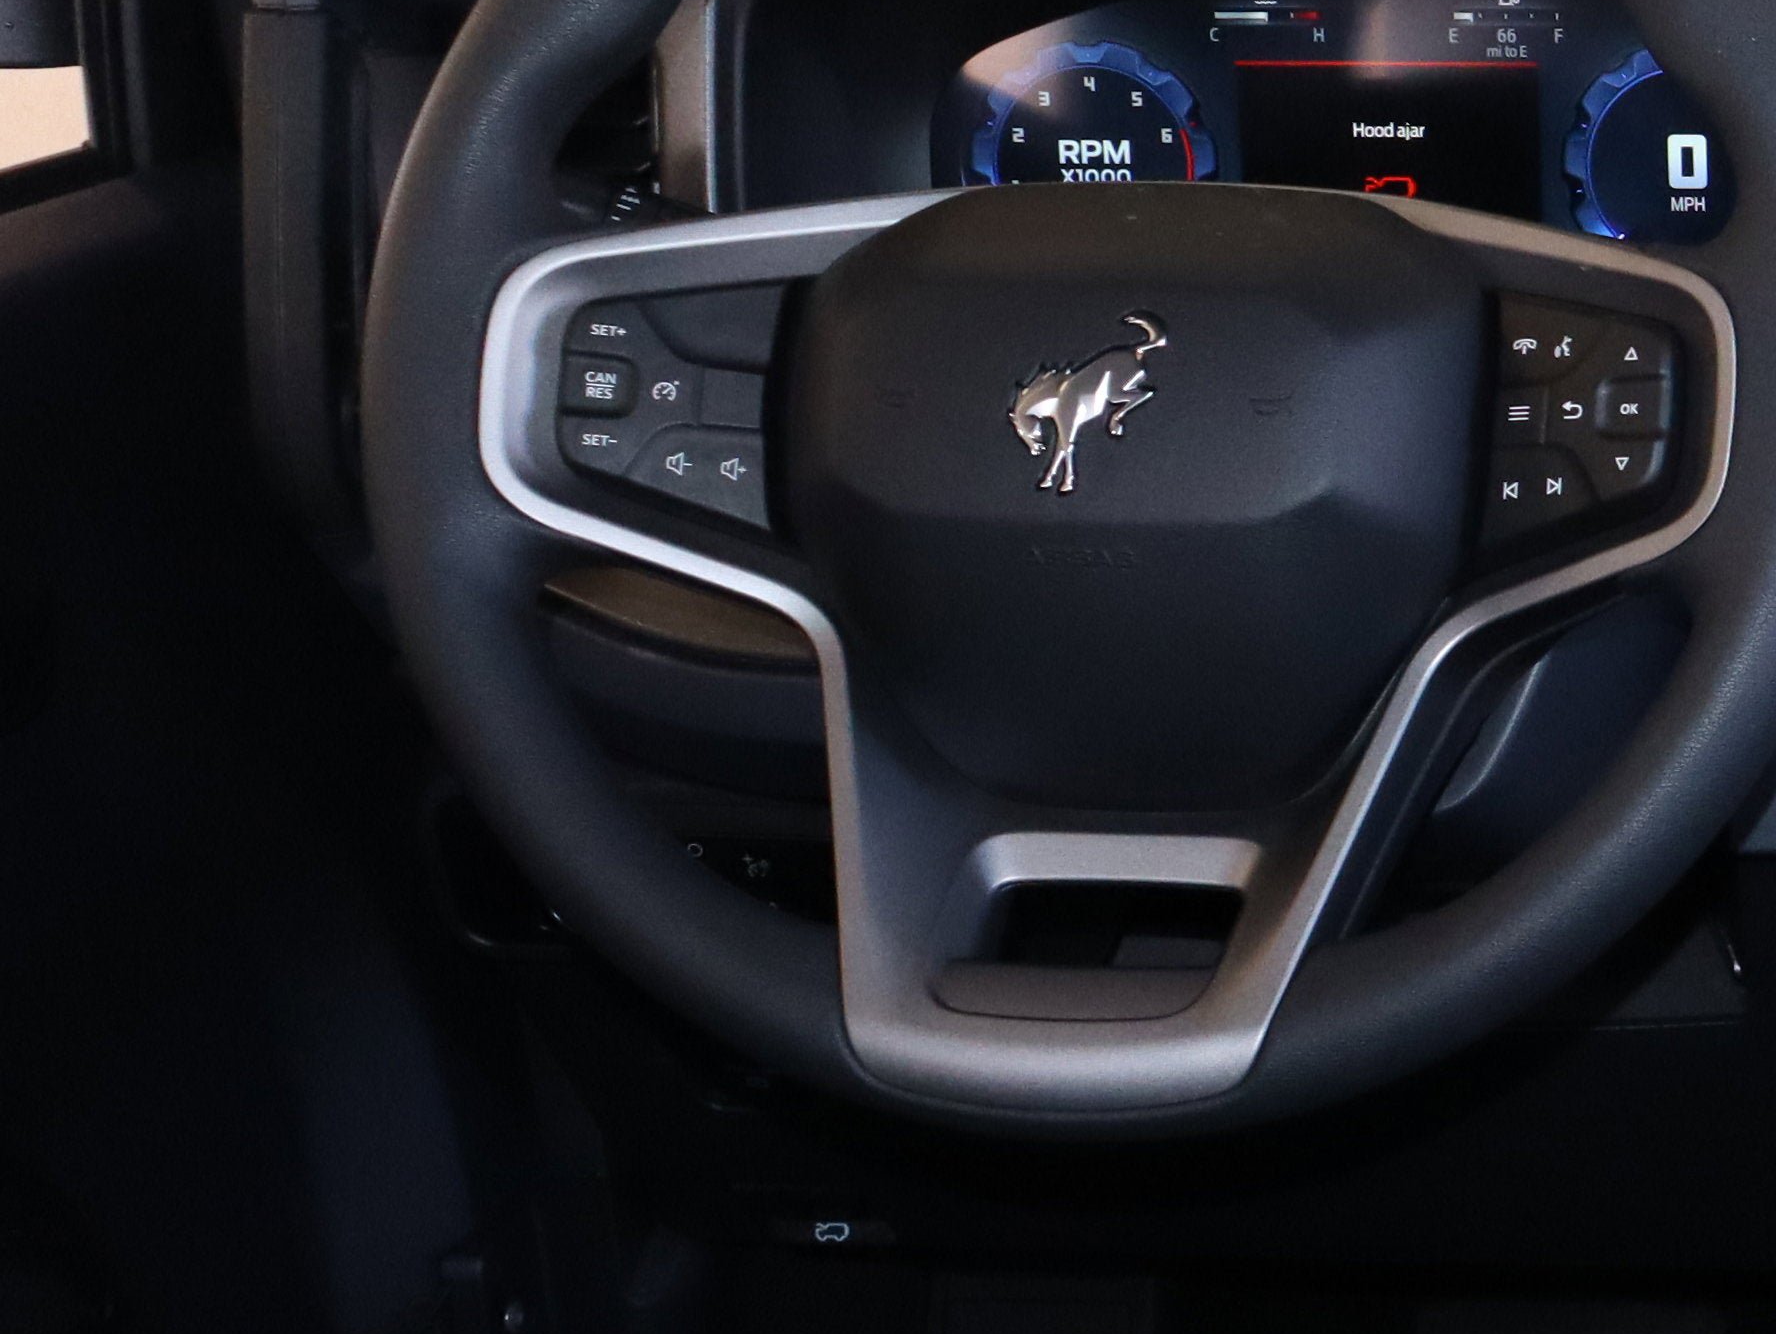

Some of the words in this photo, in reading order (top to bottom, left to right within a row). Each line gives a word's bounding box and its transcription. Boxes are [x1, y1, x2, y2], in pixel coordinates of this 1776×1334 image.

[1209, 28, 1219, 42] C
[1313, 28, 1325, 42] H
[1449, 28, 1459, 42] E
[1497, 28, 1517, 43] 66
[1554, 28, 1564, 43] F
[1486, 45, 1502, 58] mi
[1504, 45, 1517, 58] to
[1520, 45, 1528, 58] E
[1083, 76, 1096, 92] 4
[1038, 91, 1051, 106] 3
[1131, 91, 1143, 106] 5
[1012, 127, 1025, 143] 2
[1160, 127, 1173, 143] 6
[1352, 122, 1394, 138] Hood
[1397, 122, 1425, 140] ajar
[1057, 139, 1131, 165] RPM
[1667, 134, 1708, 189] 0
[1670, 196, 1706, 212] MPH
[590, 323, 627, 337] SET+
[584, 371, 617, 385] CAN
[585, 387, 613, 400] RES
[1619, 402, 1639, 416] OK
